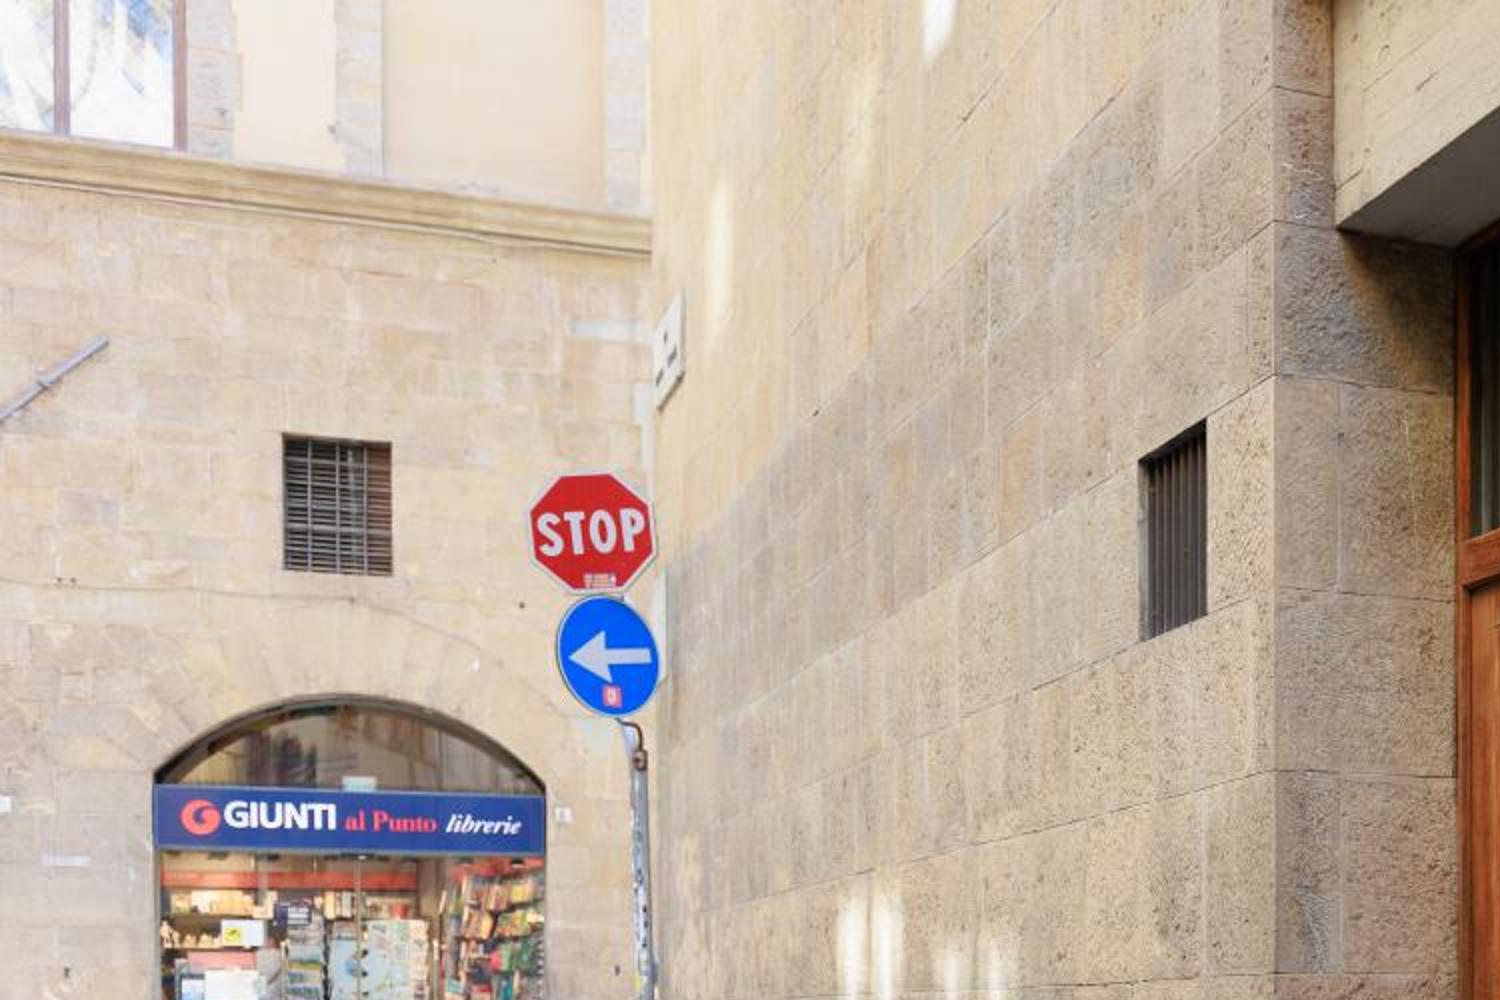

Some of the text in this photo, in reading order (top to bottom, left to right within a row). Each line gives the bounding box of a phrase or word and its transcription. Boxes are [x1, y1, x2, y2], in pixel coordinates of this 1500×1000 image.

[536, 507, 645, 557] STOP
[223, 800, 337, 831] GIUNTI
[344, 808, 366, 831] al
[372, 809, 437, 832] Punto
[445, 813, 523, 835] librerie
